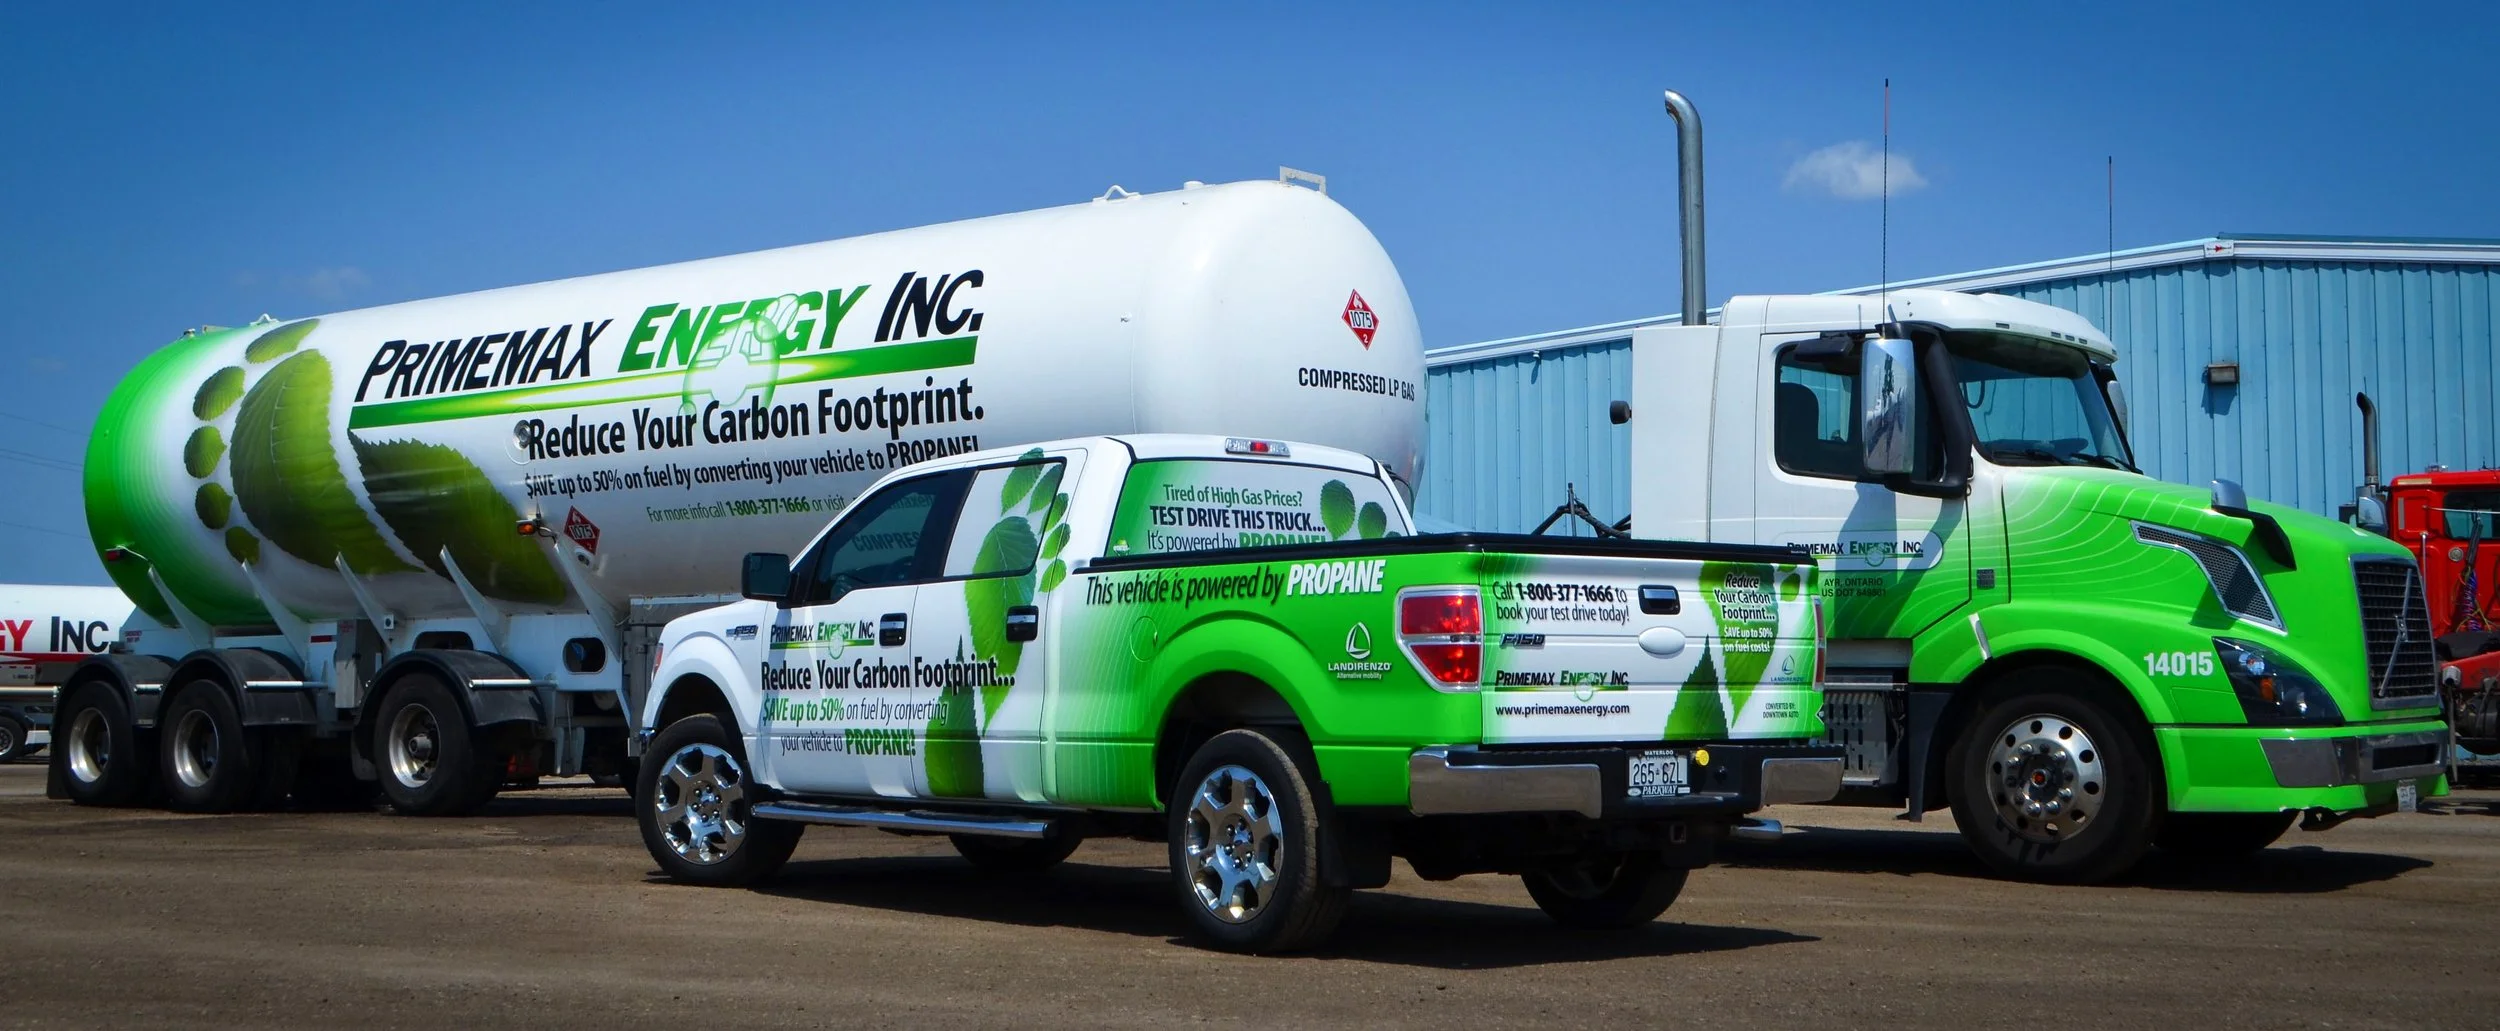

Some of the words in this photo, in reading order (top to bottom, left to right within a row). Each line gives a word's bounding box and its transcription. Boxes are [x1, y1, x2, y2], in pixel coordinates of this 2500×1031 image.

[1350, 310, 1372, 328] 1075
[354, 318, 614, 402] PRIMEMAX
[618, 284, 872, 373] ENERGY
[874, 269, 984, 343] INC.
[1362, 333, 1369, 344] 2
[1298, 367, 1386, 395] COMPRESSED
[1388, 378, 1399, 397] LP
[1401, 381, 1415, 402] GAS
[528, 414, 625, 460] Reduce
[632, 407, 697, 451] Your
[703, 395, 810, 445] Carbon
[818, 375, 984, 440] Footprint.
[525, 472, 557, 499] $AVE
[558, 478, 576, 499] up
[577, 474, 592, 493] to
[593, 468, 623, 491] 50%
[624, 471, 643, 489] on
[643, 463, 673, 488] fuel
[673, 463, 691, 490] by
[694, 456, 772, 484] converting
[773, 458, 808, 484] your
[810, 447, 865, 475] vehicle
[867, 449, 885, 470] to
[1163, 484, 1195, 502] Tired
[1197, 486, 1209, 503] of
[1211, 486, 1240, 508] High
[1241, 488, 1263, 506] Gas
[1264, 489, 1303, 507] Prices?
[646, 506, 664, 523] For
[665, 504, 690, 522] more
[691, 502, 708, 519] info
[709, 501, 725, 518] call
[725, 496, 811, 517] 1-800-377-1666
[812, 498, 824, 512] or
[824, 494, 846, 511] visit
[1149, 505, 1184, 526] TEST
[1187, 507, 1231, 528] DRIVE
[1231, 509, 1265, 530] THIS
[1266, 511, 1326, 532] TRUCK...
[1147, 530, 1164, 550] It's
[1166, 532, 1220, 552] powered
[1222, 532, 1237, 549] by
[1903, 540, 1924, 553] INC.
[1086, 576, 1113, 605] This
[1117, 571, 1169, 603] vehicle
[1171, 572, 1185, 602] is
[1185, 565, 1261, 609] powered
[1261, 565, 1285, 606] by
[1286, 559, 1386, 596] PROPANE
[1493, 580, 1514, 601] Call
[1515, 582, 1614, 602] 1-800-377-1666
[1615, 587, 1627, 603] to
[1725, 573, 1759, 589] Reduce
[1845, 577, 1884, 587] ONTARIO
[1714, 589, 1736, 604] Your
[1737, 590, 1771, 604] Carbon
[1821, 588, 1834, 598] US
[1496, 602, 1523, 620] book
[1525, 606, 1549, 624] your
[1550, 605, 1569, 621] test
[1572, 604, 1597, 621] drive
[1599, 604, 1630, 626] today!
[1722, 605, 1775, 623] Footprint...
[0, 619, 33, 652] Y
[771, 624, 815, 643] PRIMEMAX
[858, 620, 875, 639] INC.
[1741, 629, 1750, 640] up
[1751, 628, 1758, 637] to
[1758, 627, 1773, 638] 50%
[1725, 644, 1734, 652] on
[1735, 641, 1749, 652] fuel
[1750, 641, 1770, 652] costs!
[761, 660, 812, 691] Reduce
[816, 659, 850, 689] Your
[853, 656, 911, 689] Carbon
[914, 653, 1016, 696] Footprint...
[1328, 662, 1391, 671] LANDIRENZO
[2143, 651, 2213, 676] 14015
[1362, 672, 1382, 680] mobility
[1495, 670, 1555, 686] PRIMEMAX
[1611, 670, 1629, 686] INC.
[763, 693, 789, 726] $AVE
[790, 701, 805, 728] up
[806, 699, 818, 721] to
[819, 697, 845, 721] 50%
[846, 703, 860, 721] on
[860, 697, 879, 720] fuel
[880, 698, 893, 726] by
[894, 698, 948, 727] converting
[1495, 703, 1630, 718] www.primemaxenergy.com
[1765, 702, 1788, 710] CONVERTED
[780, 733, 801, 756] your
[801, 730, 832, 752] vehicle
[833, 733, 843, 751] to
[844, 728, 916, 757] PROPANE!
[1642, 785, 1677, 796] PARKWAY
